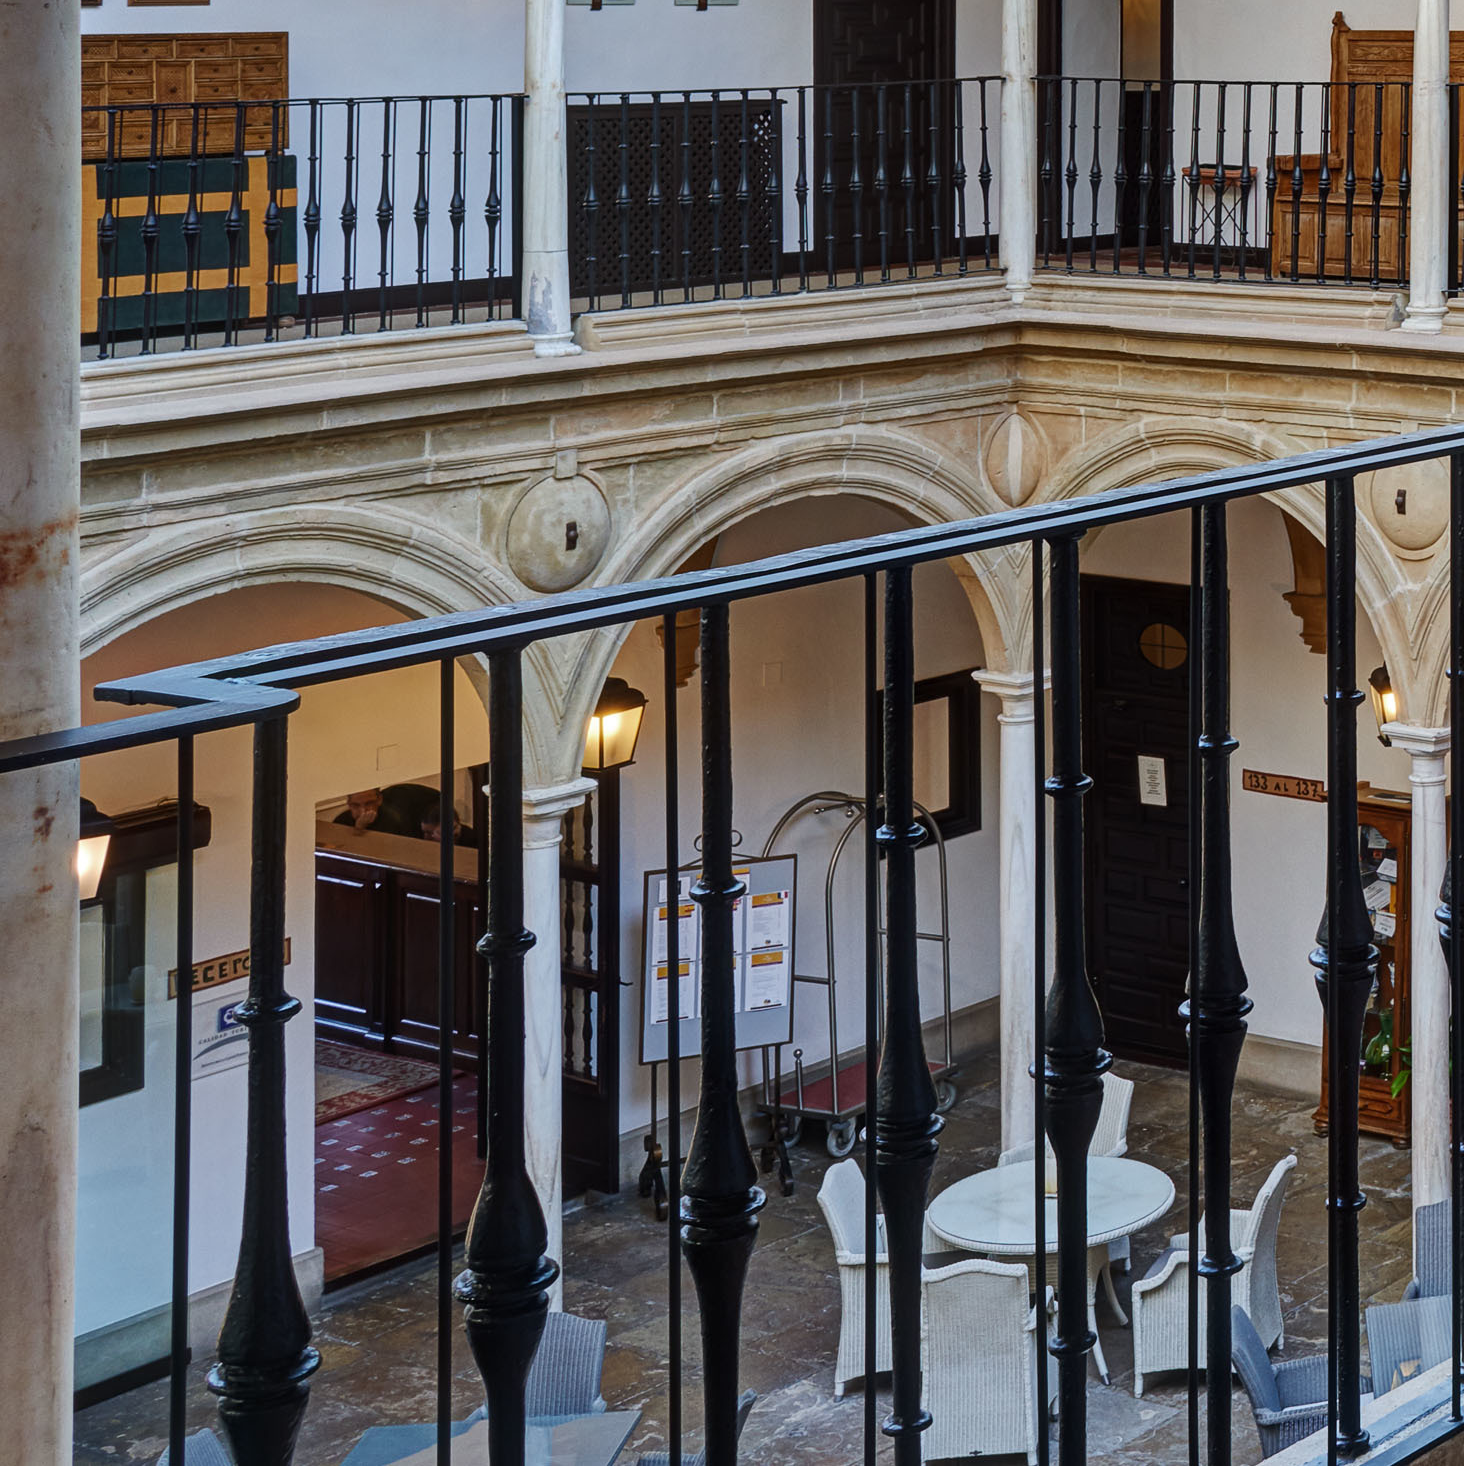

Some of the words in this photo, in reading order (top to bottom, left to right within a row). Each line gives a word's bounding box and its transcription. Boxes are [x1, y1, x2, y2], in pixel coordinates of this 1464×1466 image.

[1248, 774, 1268, 790] 133
[1274, 782, 1288, 792] AL
[1296, 781, 1318, 797] 137
